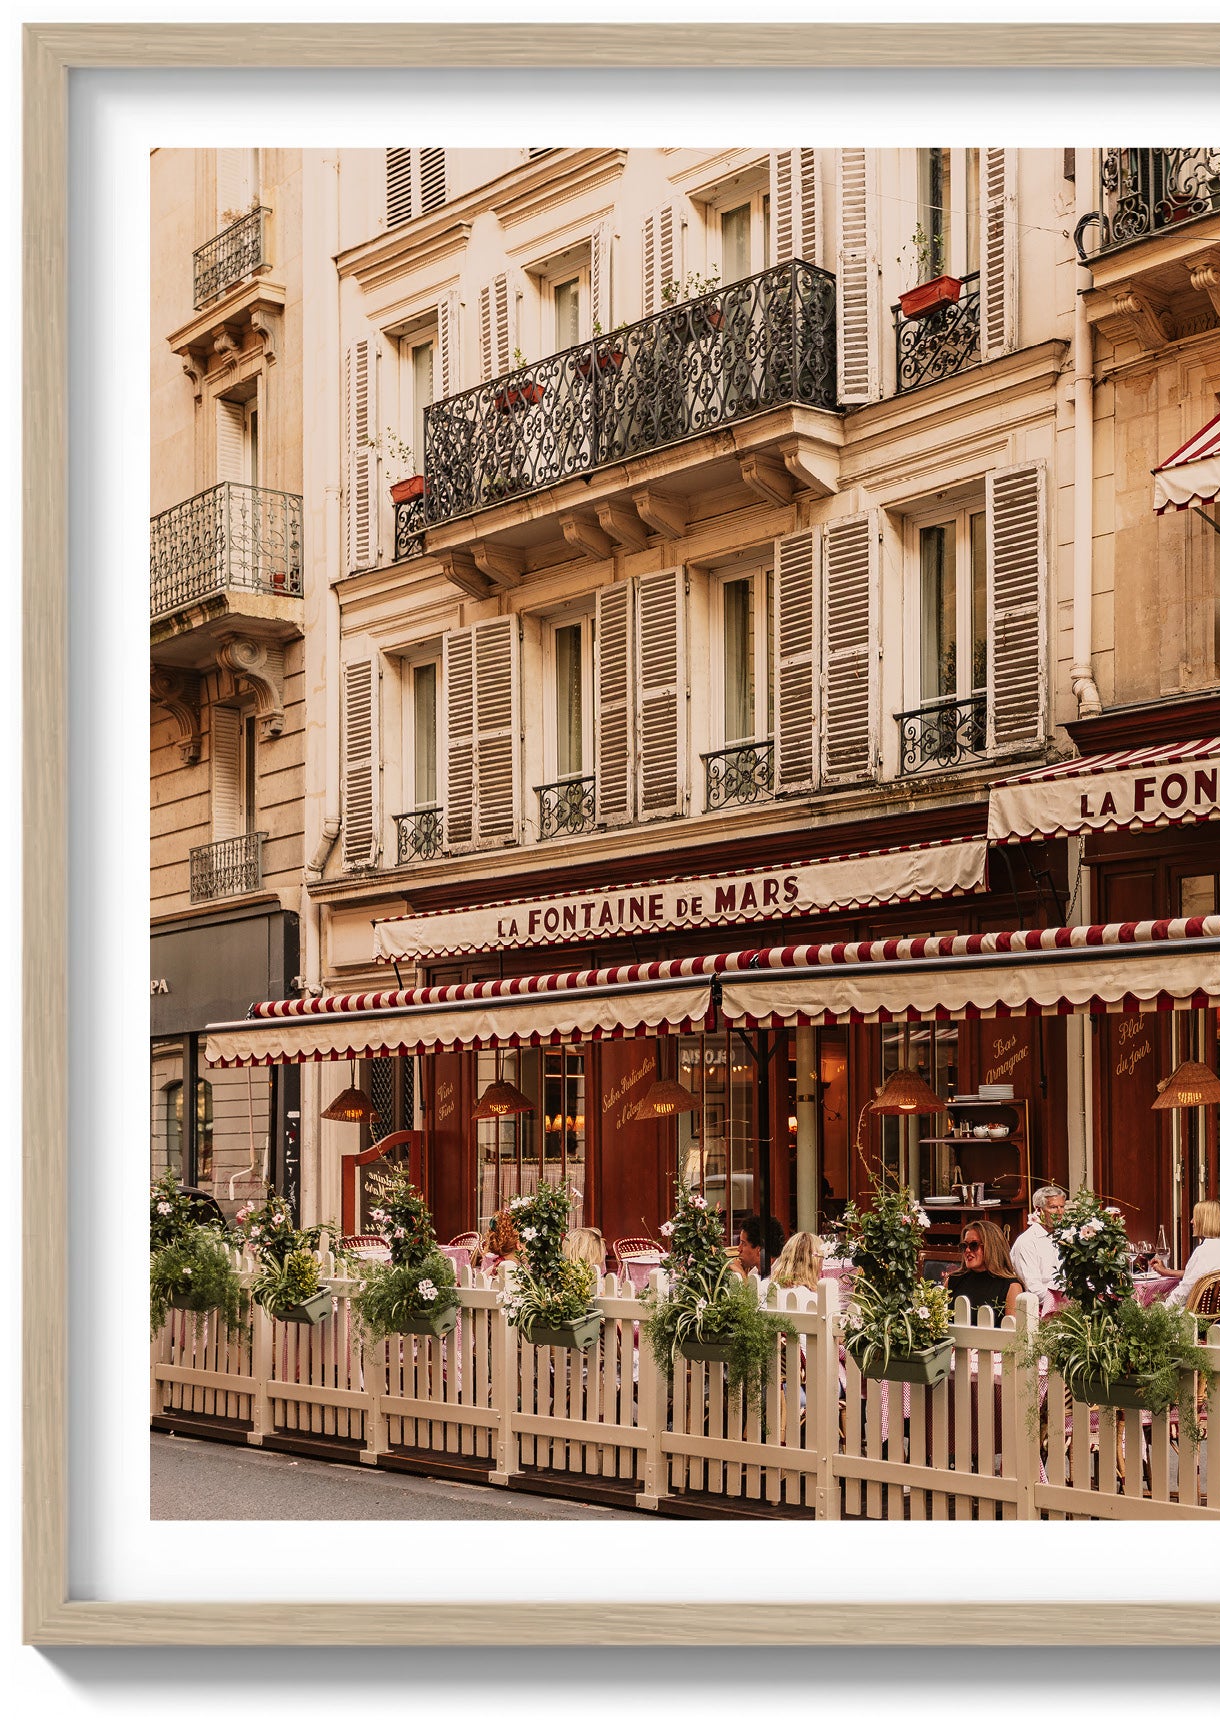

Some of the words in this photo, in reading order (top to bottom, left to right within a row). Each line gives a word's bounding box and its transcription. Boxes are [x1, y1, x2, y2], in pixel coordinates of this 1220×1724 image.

[1080, 791, 1117, 819] LA
[497, 918, 519, 938] LA
[528, 893, 664, 935] FONTAINE
[676, 896, 702, 918] DE
[715, 875, 799, 914] MARS
[1119, 1012, 1145, 1045] Plat
[993, 1034, 1016, 1059] Bas
[1117, 1054, 1128, 1075] du
[1129, 1040, 1151, 1075] jour
